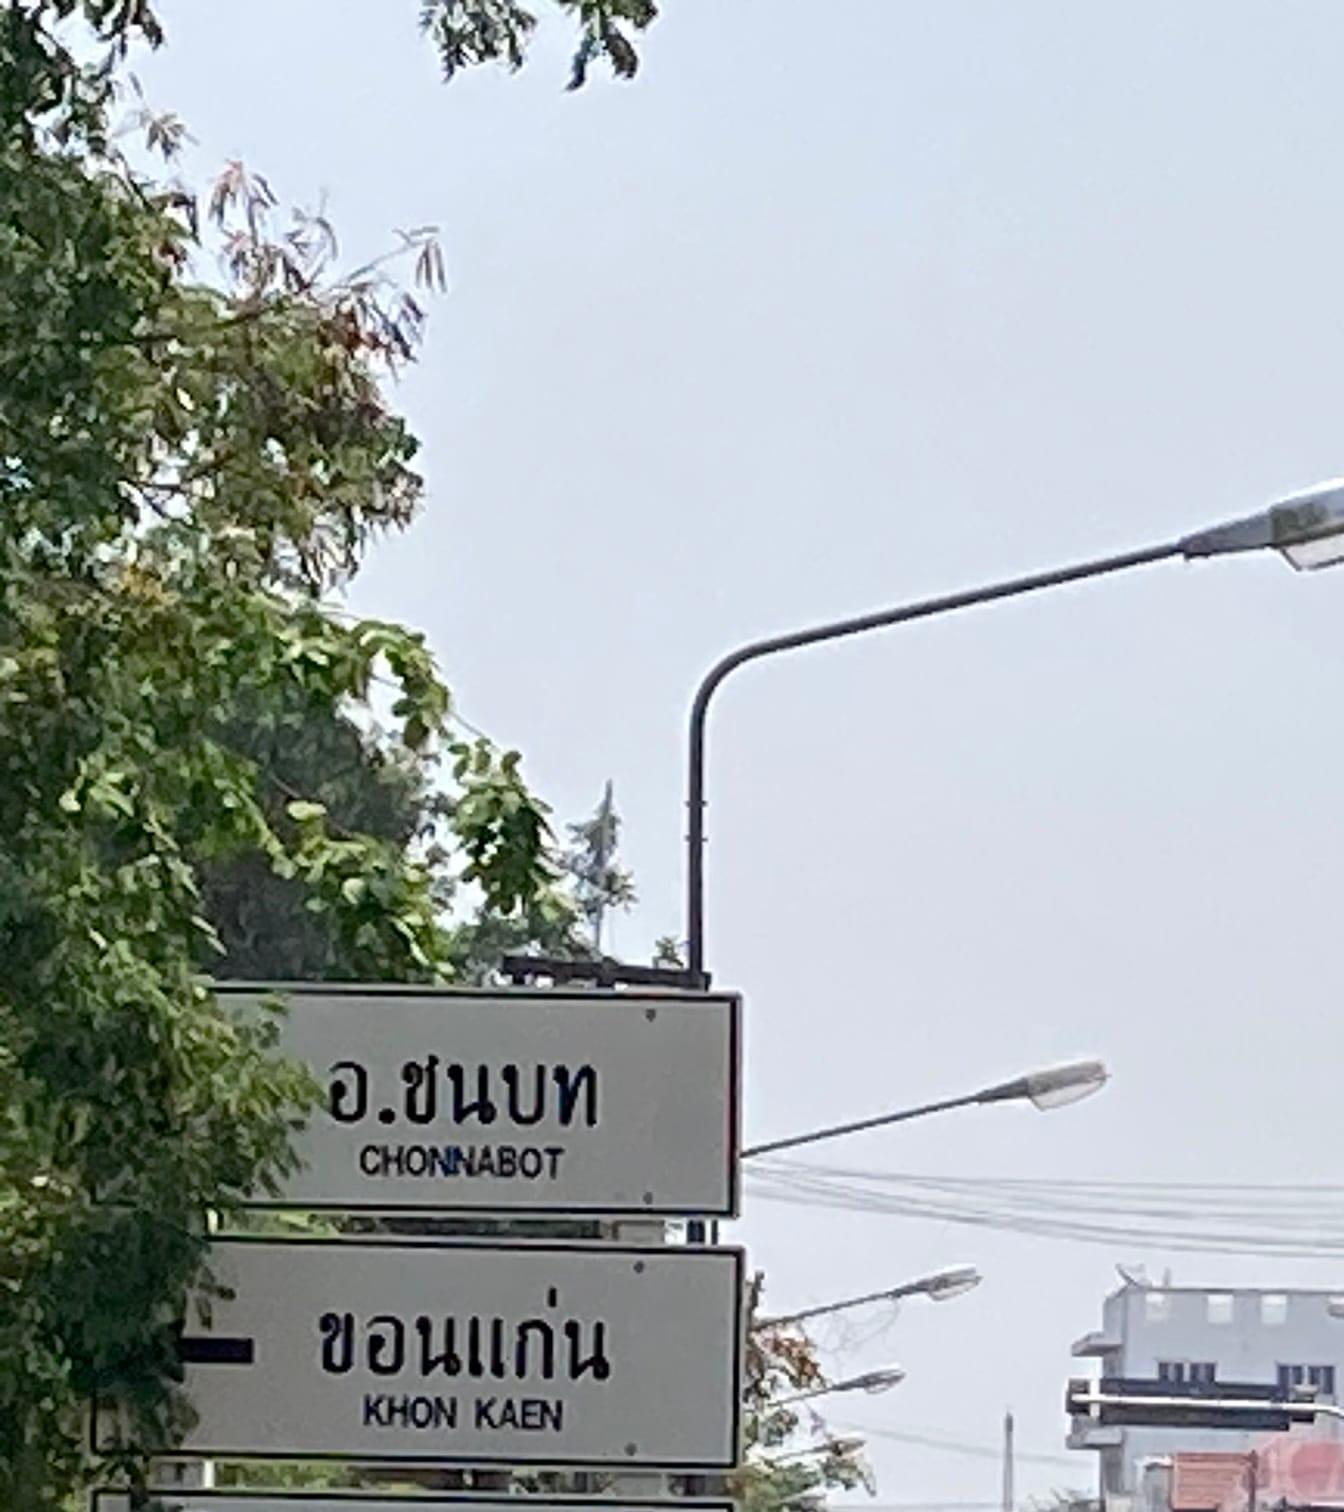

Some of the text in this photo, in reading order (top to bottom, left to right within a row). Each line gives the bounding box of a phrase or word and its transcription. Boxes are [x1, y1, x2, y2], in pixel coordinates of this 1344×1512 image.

[328, 1055, 598, 1127] อ.ชนบท
[359, 1145, 566, 1179] CHONNABOT
[319, 1286, 611, 1381] ขอนแก่น
[362, 1394, 564, 1432] KHON KAEN
